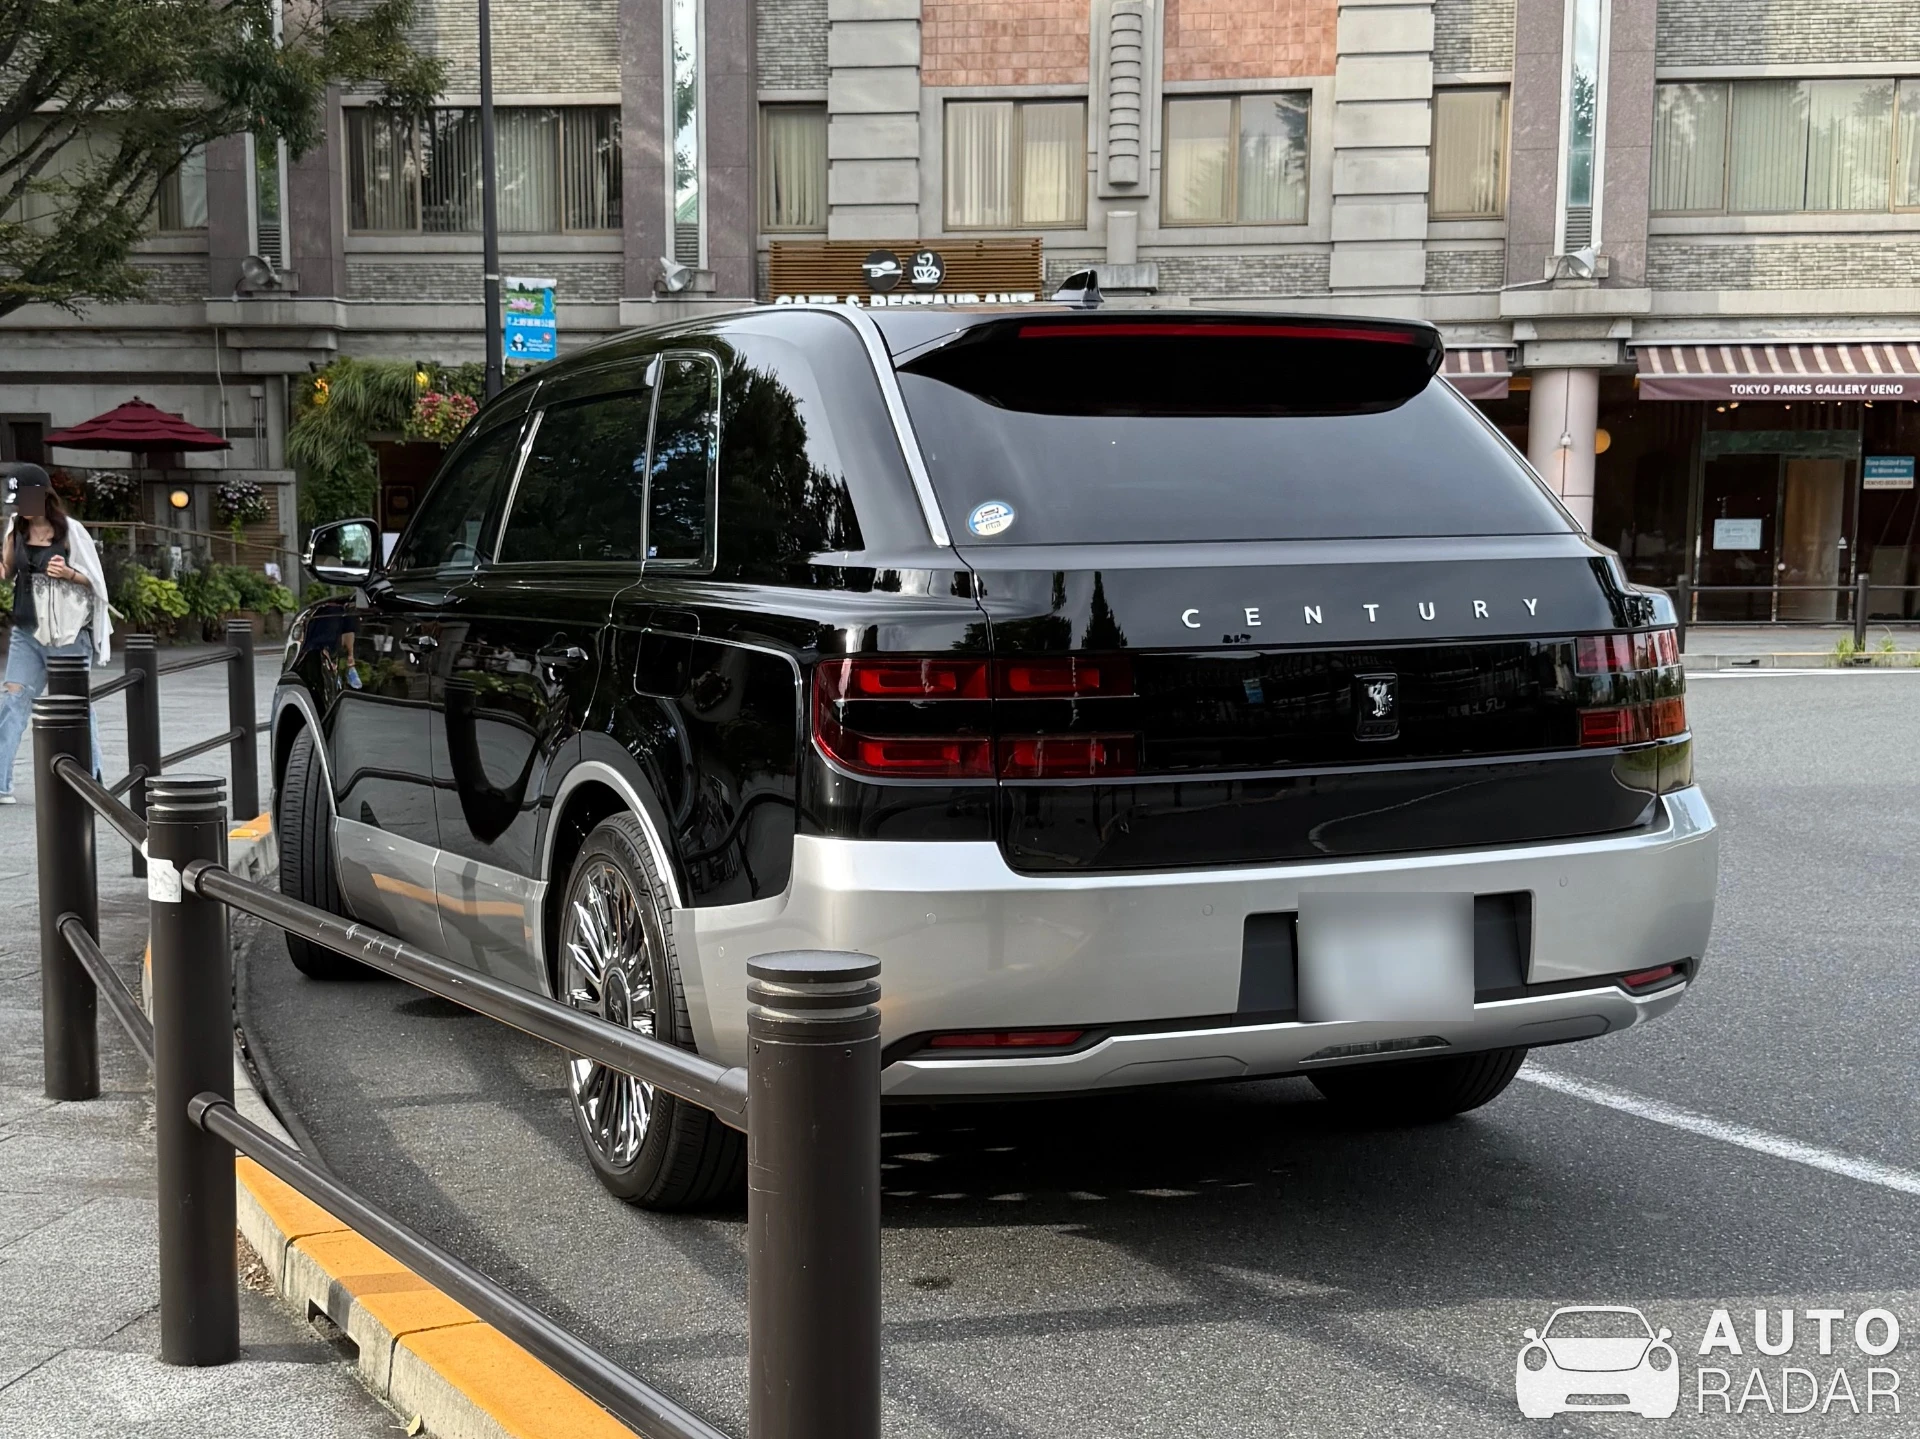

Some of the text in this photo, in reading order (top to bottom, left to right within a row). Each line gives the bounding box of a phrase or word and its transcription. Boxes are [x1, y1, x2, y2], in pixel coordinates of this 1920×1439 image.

[1730, 384, 1903, 395] TOKYO PARKS GALLERY UENO
[1181, 598, 1538, 629] CENTURY
